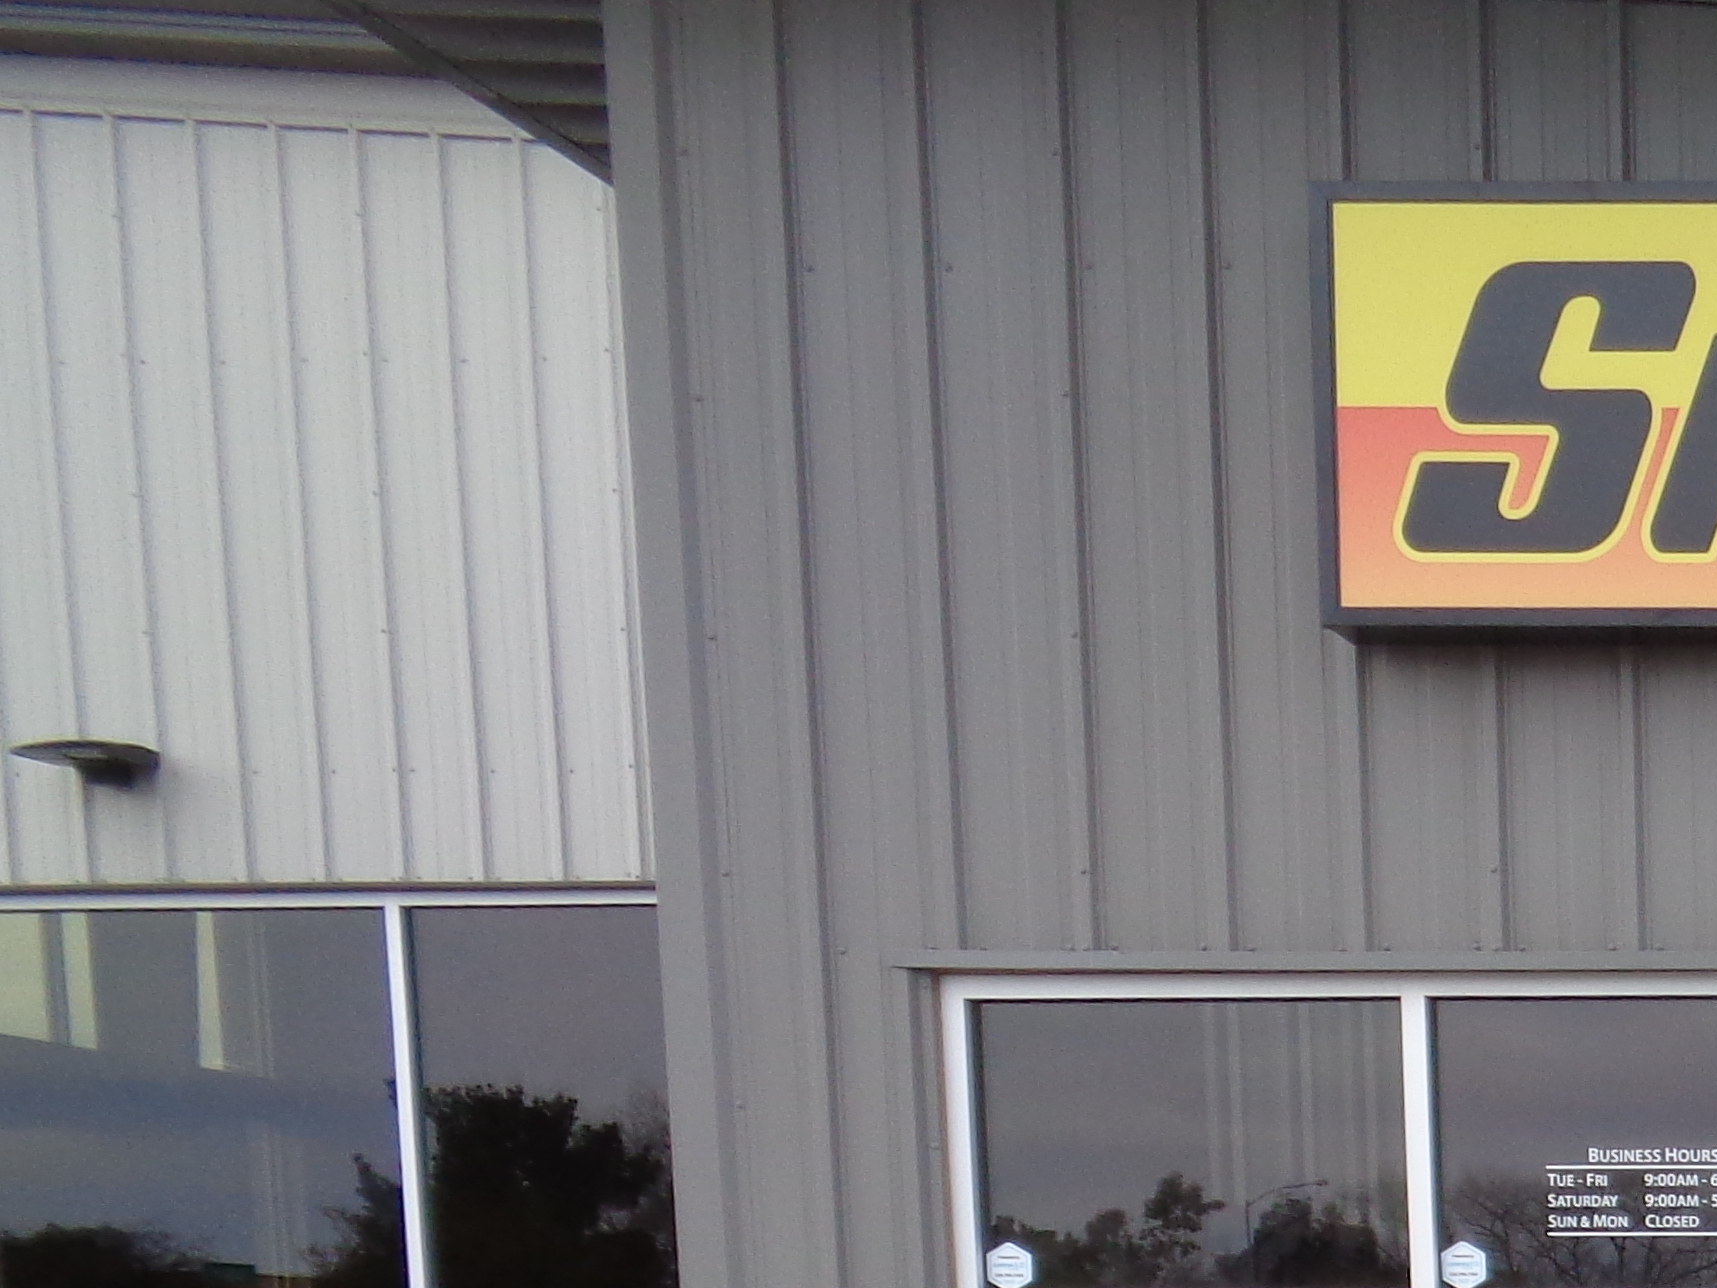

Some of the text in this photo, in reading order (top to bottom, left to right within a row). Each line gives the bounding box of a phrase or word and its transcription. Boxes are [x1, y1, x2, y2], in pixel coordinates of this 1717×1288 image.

[1547, 1173, 1574, 1187] TUE
[1643, 1173, 1699, 1188] 9:00AM
[1644, 1194, 1699, 1208] 9:00AM
[1580, 1215, 1590, 1228] &
